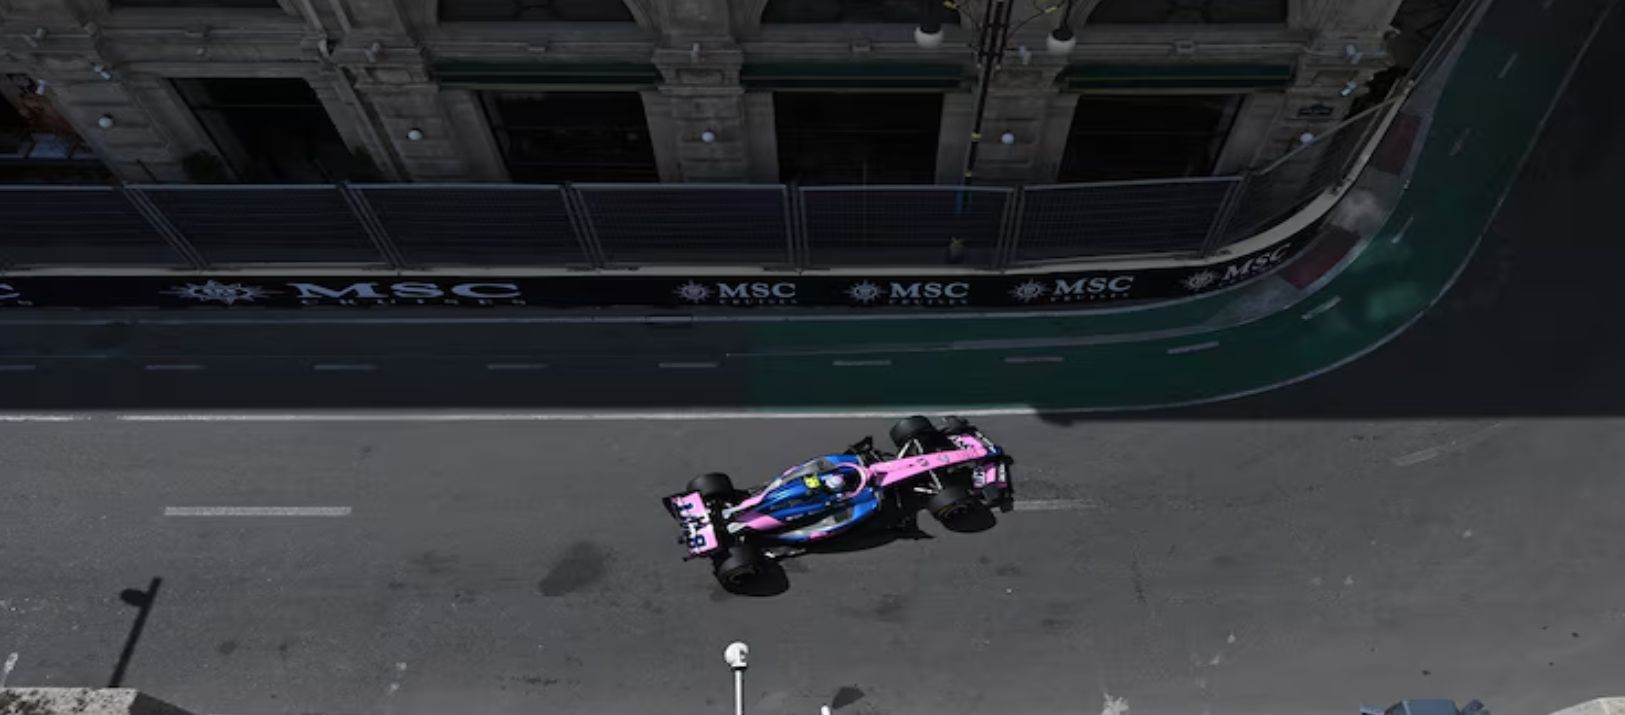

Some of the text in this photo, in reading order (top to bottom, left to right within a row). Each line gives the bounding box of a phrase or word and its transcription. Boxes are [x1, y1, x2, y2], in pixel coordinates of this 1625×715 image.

[1222, 243, 1291, 281] MSC
[286, 282, 520, 298] MSC
[717, 281, 797, 298] MSC
[889, 281, 970, 298] MSC
[1054, 275, 1135, 295] MSC
